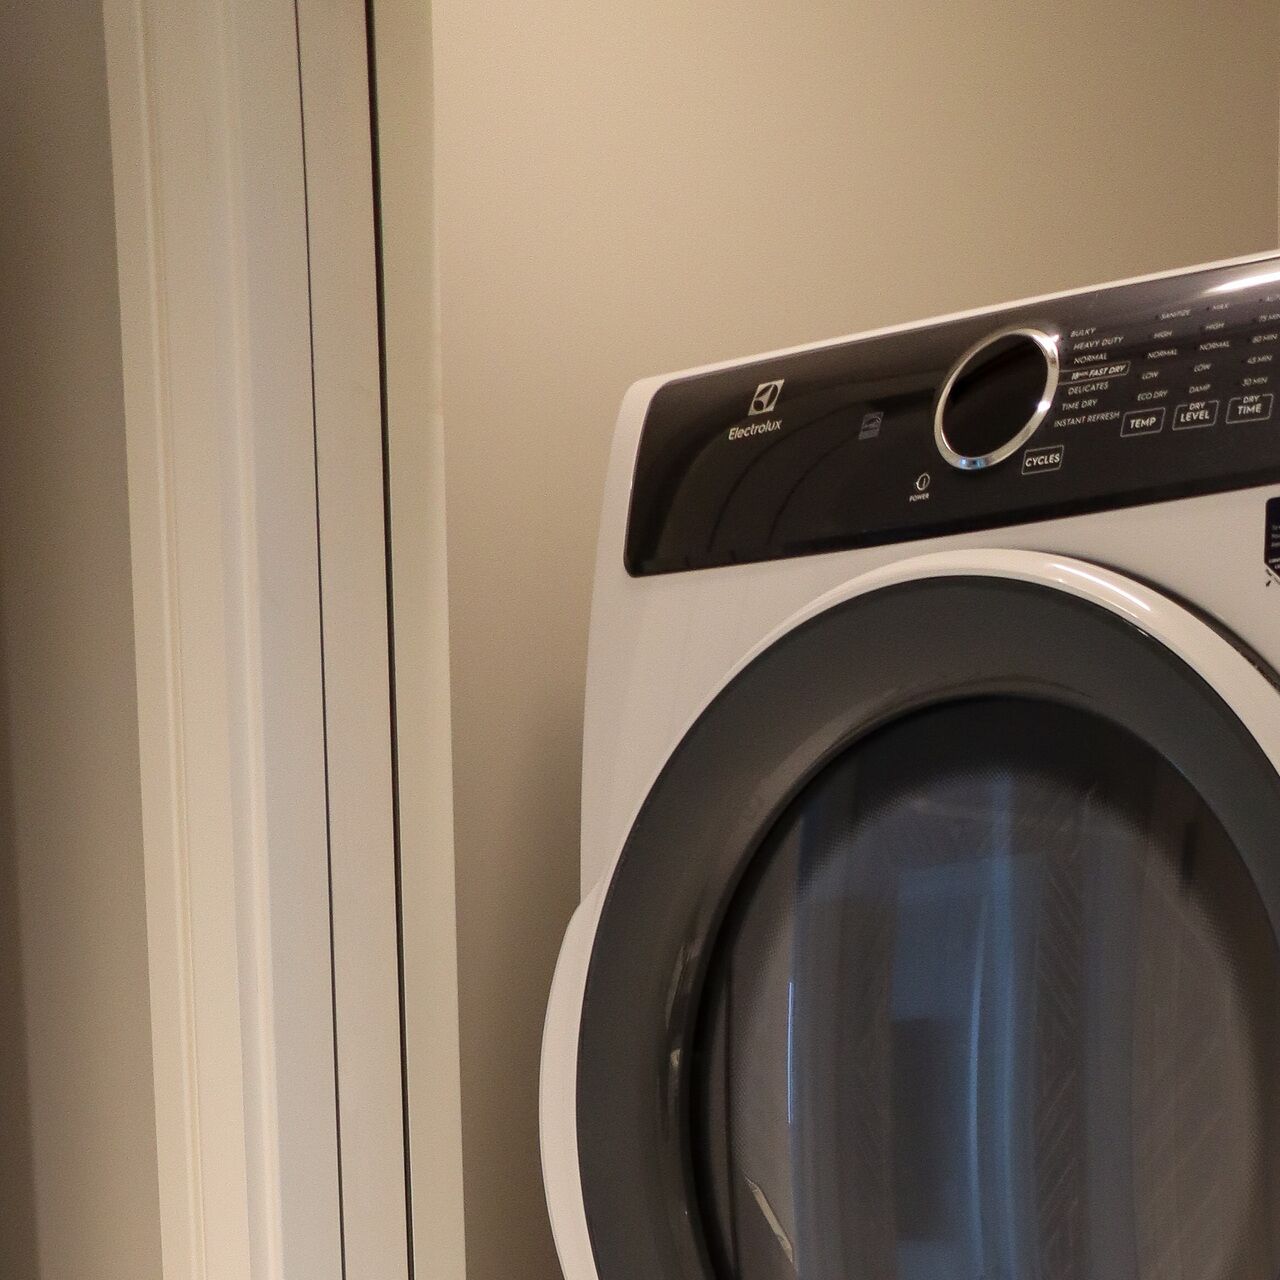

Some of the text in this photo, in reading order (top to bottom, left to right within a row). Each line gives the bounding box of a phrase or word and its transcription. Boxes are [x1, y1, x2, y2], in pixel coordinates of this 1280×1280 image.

[1070, 327, 1097, 338] BULKY
[1073, 336, 1125, 350] HEAVY DUTY
[1200, 341, 1230, 351] NORMAL
[1073, 352, 1108, 364] NORMAL
[1148, 348, 1178, 359] NORMAL
[1088, 366, 1109, 378] FAST
[1108, 364, 1127, 374] DRY
[1193, 363, 1212, 373] LOW
[1141, 371, 1159, 380] LOW
[1067, 381, 1109, 396] DELICATES
[1153, 389, 1169, 400] DRY
[1188, 384, 1211, 394] DAMP
[1061, 399, 1098, 411] TIME DRY
[1243, 395, 1261, 404] DRY
[1189, 401, 1206, 411] DRY
[1237, 403, 1262, 415] TIME
[1053, 411, 1121, 428] INSTANT REFRESH
[1130, 416, 1157, 429] TEMP
[1180, 410, 1210, 423] LEVEL
[728, 419, 783, 441] Electrolux
[1025, 453, 1061, 467] CYCLES
